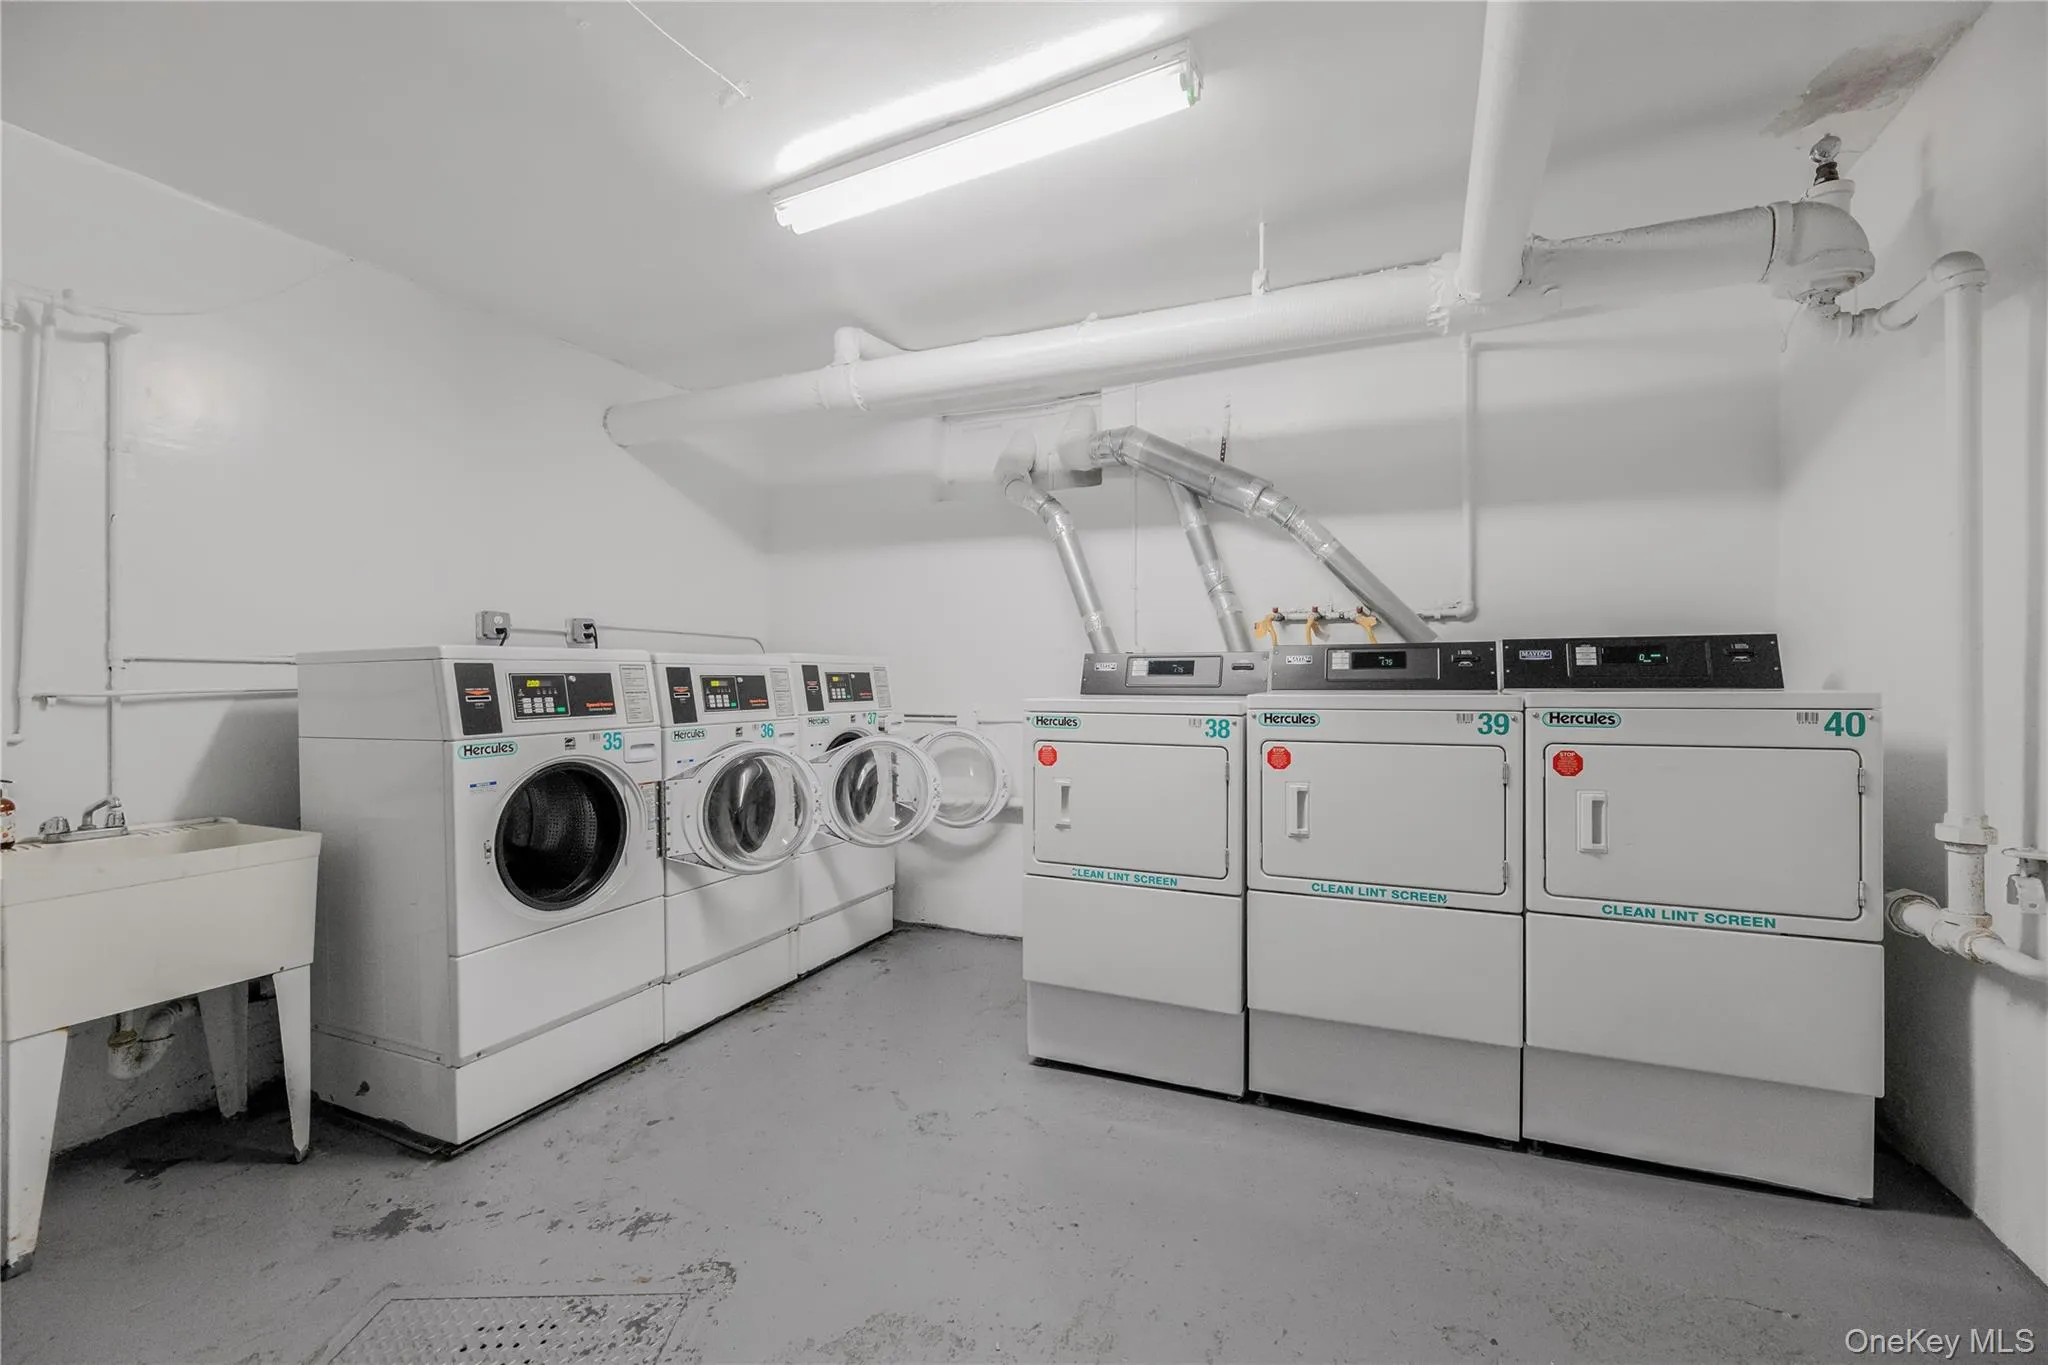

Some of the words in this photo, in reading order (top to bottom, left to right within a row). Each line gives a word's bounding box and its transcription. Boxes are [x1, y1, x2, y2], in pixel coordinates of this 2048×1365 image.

[808, 717, 829, 726] Hercules
[867, 712, 877, 725] 37
[1035, 716, 1078, 727] Hercules
[1264, 712, 1316, 725] Hercules
[1477, 713, 1509, 735] 39
[1548, 712, 1616, 727] Hercules
[1823, 712, 1866, 737] 40
[673, 729, 705, 741] Hercules
[760, 723, 774, 738] 36
[1204, 718, 1230, 738] 38
[603, 732, 623, 751] 35
[463, 743, 514, 757] Hercules
[1107, 871, 1130, 883] LINT
[1134, 873, 1178, 887] SCREEN
[1311, 882, 1354, 897] CLEAN
[1358, 886, 1386, 899] LINT
[1391, 889, 1447, 904] SCREEN
[1601, 904, 1656, 919] CLEAN
[1661, 909, 1699, 923] LINT
[1704, 912, 1776, 929] SCREEN
